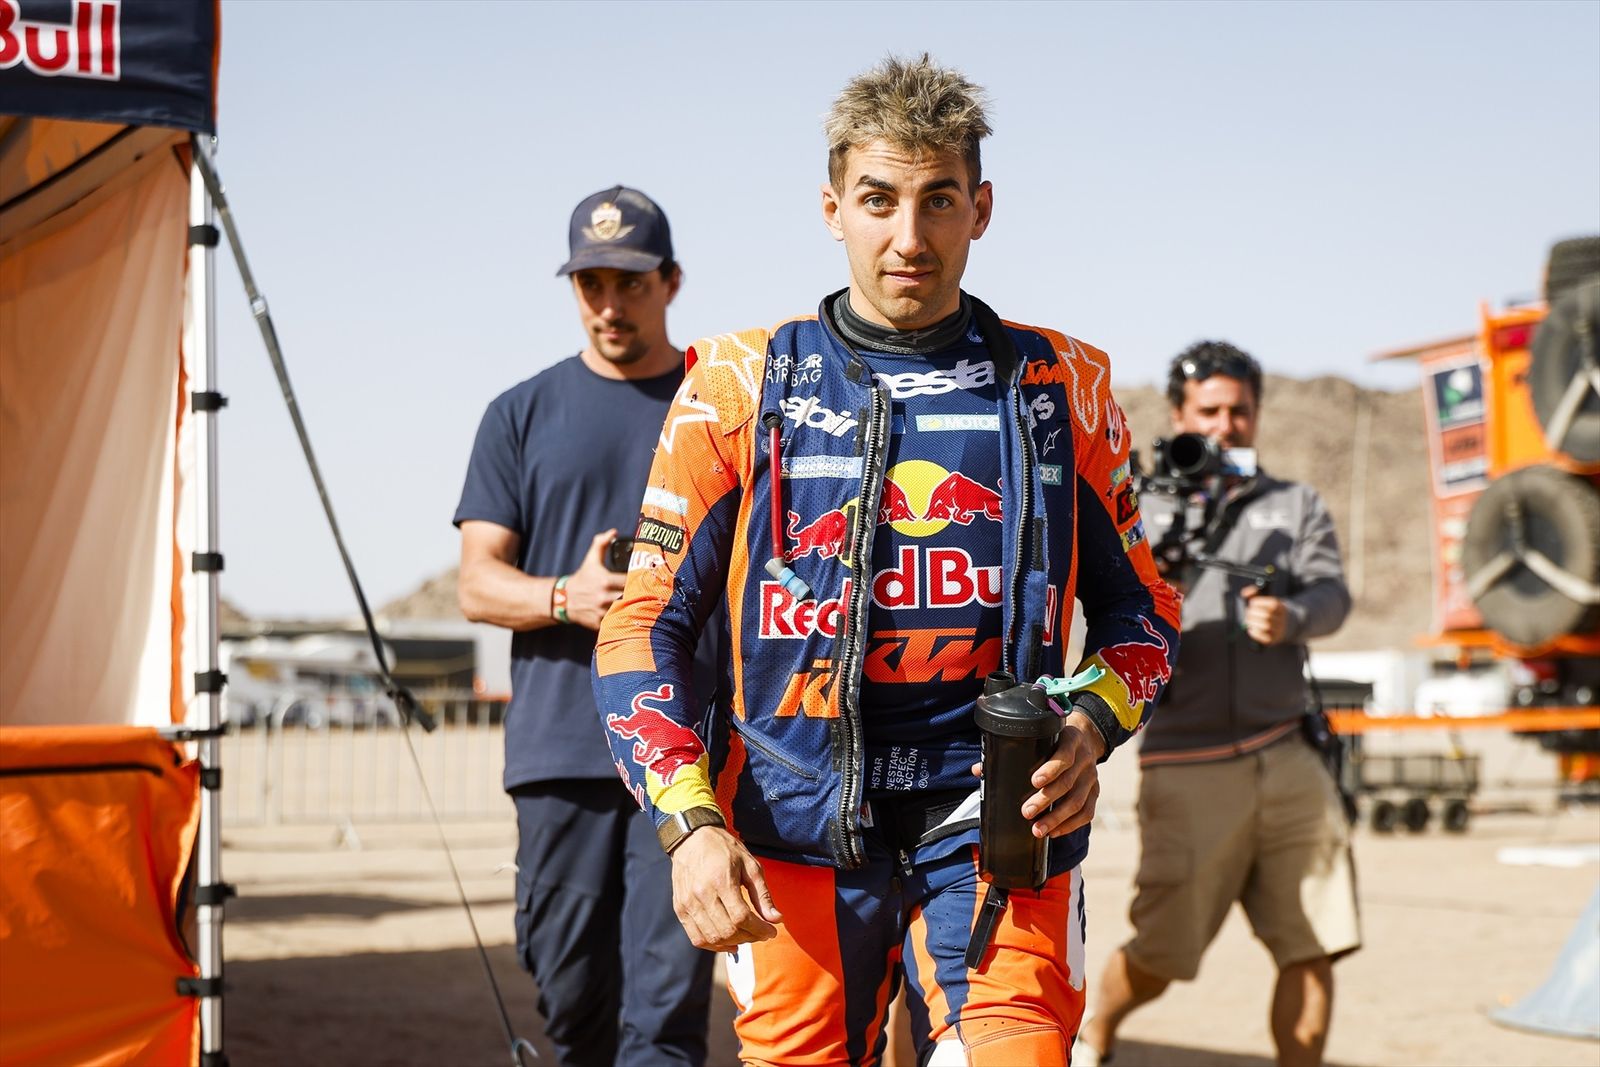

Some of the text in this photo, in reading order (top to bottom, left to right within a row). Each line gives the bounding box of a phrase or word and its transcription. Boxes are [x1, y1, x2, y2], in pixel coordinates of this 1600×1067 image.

[1021, 359, 1065, 385] TM
[864, 628, 1002, 683] KTM
[896, 757, 908, 784] SPEC
